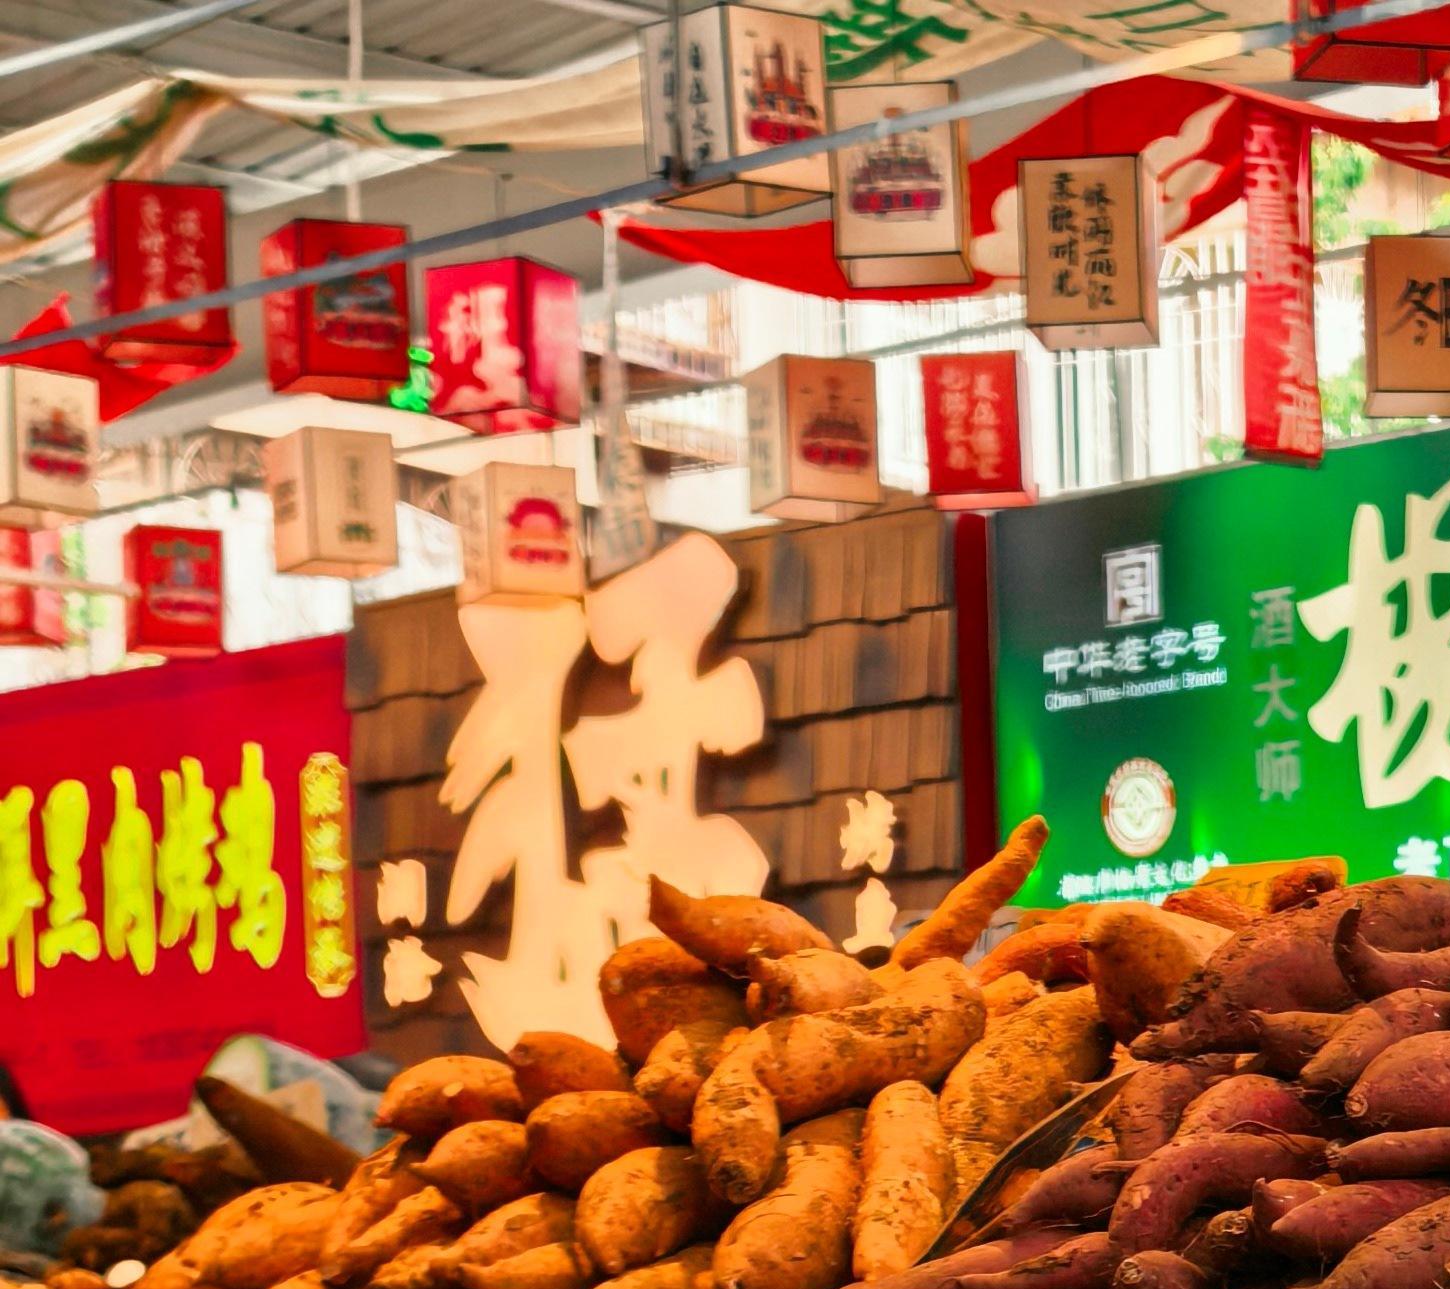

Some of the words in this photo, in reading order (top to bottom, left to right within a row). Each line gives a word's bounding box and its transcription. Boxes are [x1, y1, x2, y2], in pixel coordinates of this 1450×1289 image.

[1042, 620, 1227, 685] 中华老字号
